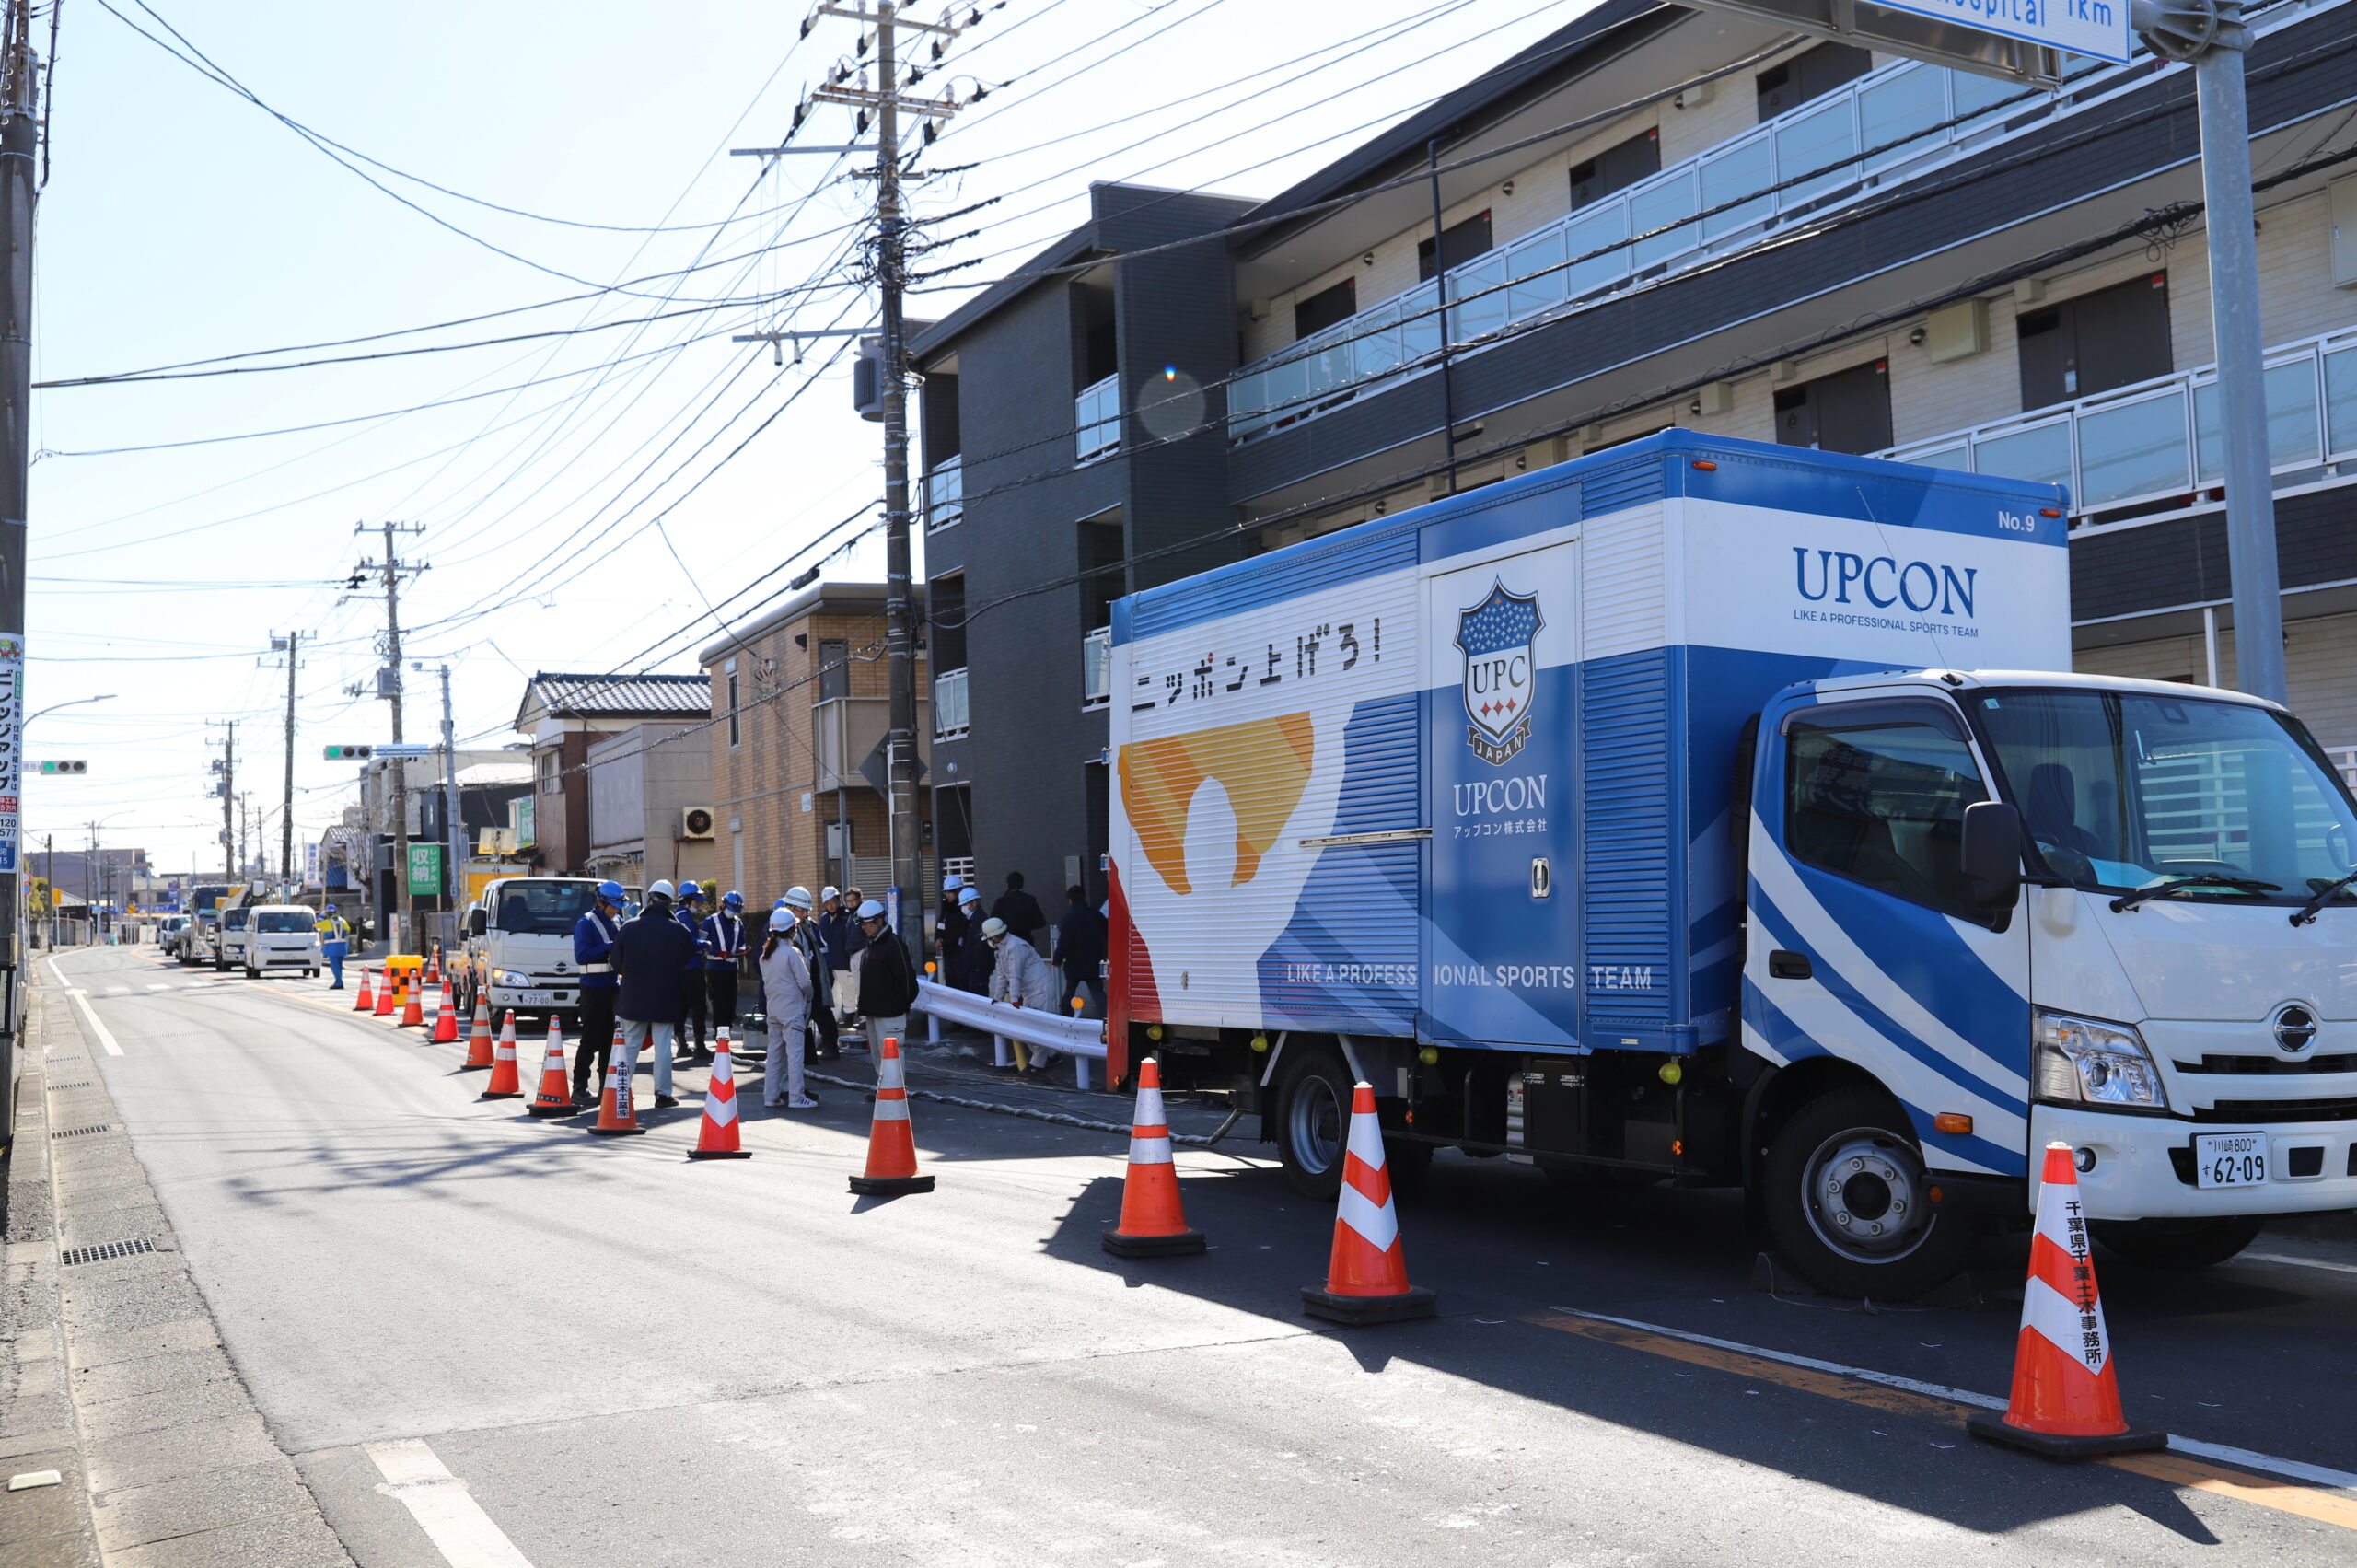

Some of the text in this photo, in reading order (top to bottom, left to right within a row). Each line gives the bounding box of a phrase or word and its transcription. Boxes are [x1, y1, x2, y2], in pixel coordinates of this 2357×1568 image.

[1999, 511, 2035, 532] No.9
[1793, 546, 1978, 619] UPCON
[1794, 609, 1979, 638] LIKE A PROFESSIONAL SPORTS TEAM
[1472, 655, 1526, 694] UPC
[1477, 736, 1522, 763] JAPAN
[1453, 774, 1547, 817] UPCON
[1454, 818, 1547, 839] アップコン株式会社
[412, 848, 429, 882] 収納
[1287, 963, 1321, 983] LIKE
[1325, 964, 1335, 983] A
[1495, 965, 1574, 988] SPORTS
[1591, 966, 1652, 990] TEAM
[2065, 1201, 2102, 1365] 千葉県千葉土木事務所
